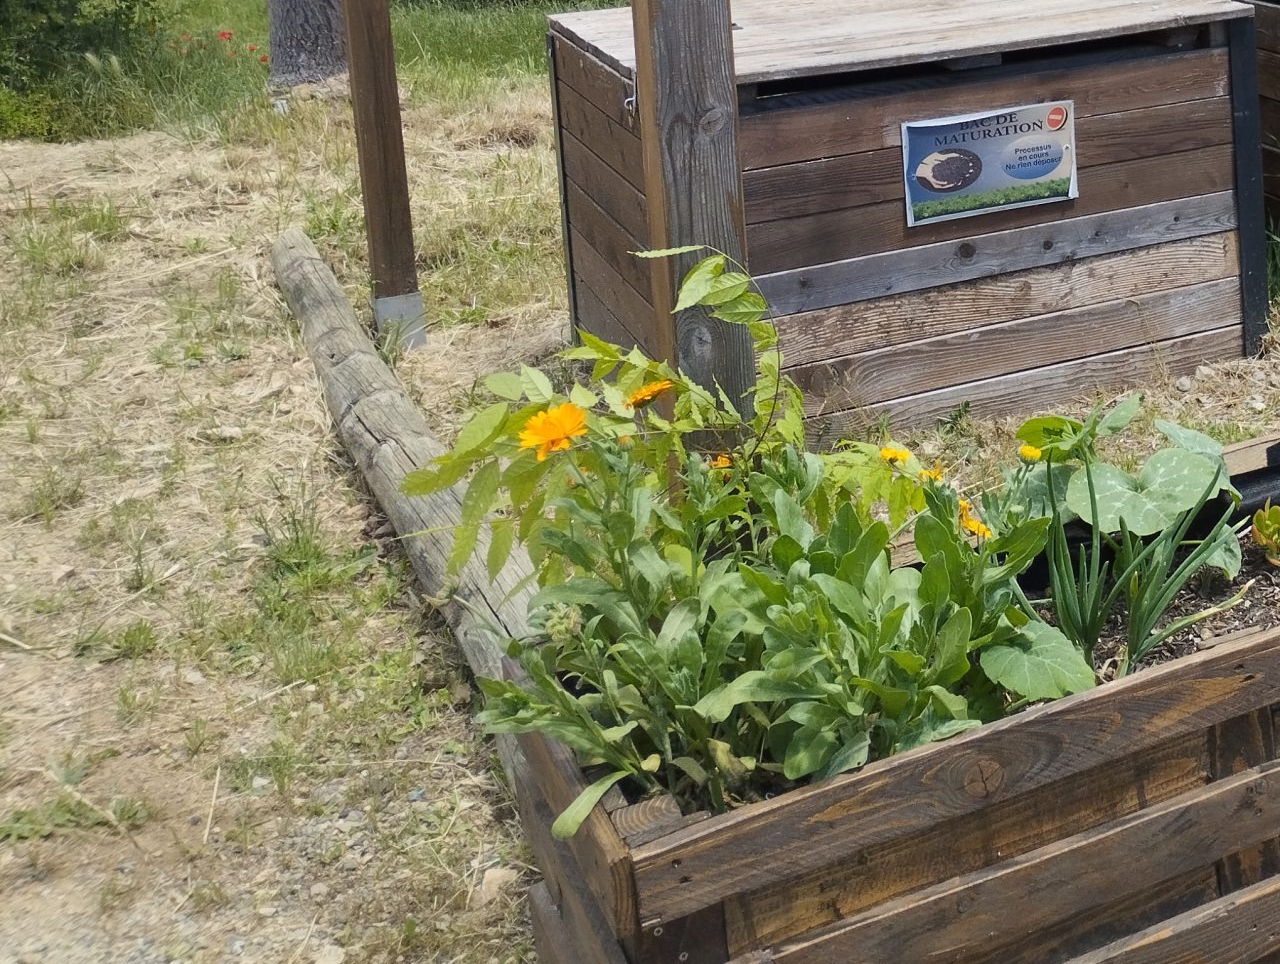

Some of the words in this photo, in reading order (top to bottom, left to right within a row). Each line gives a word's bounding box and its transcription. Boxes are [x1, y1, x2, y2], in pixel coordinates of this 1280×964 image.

[959, 116, 991, 131] BAC
[997, 113, 1018, 125] DE
[934, 119, 1044, 147] MATURATION
[1014, 144, 1052, 155] Processus
[1018, 152, 1027, 161] en
[1029, 151, 1049, 160] cours
[1005, 163, 1016, 171] Ne
[1018, 160, 1031, 169] rien
[1033, 156, 1062, 167] déposer
